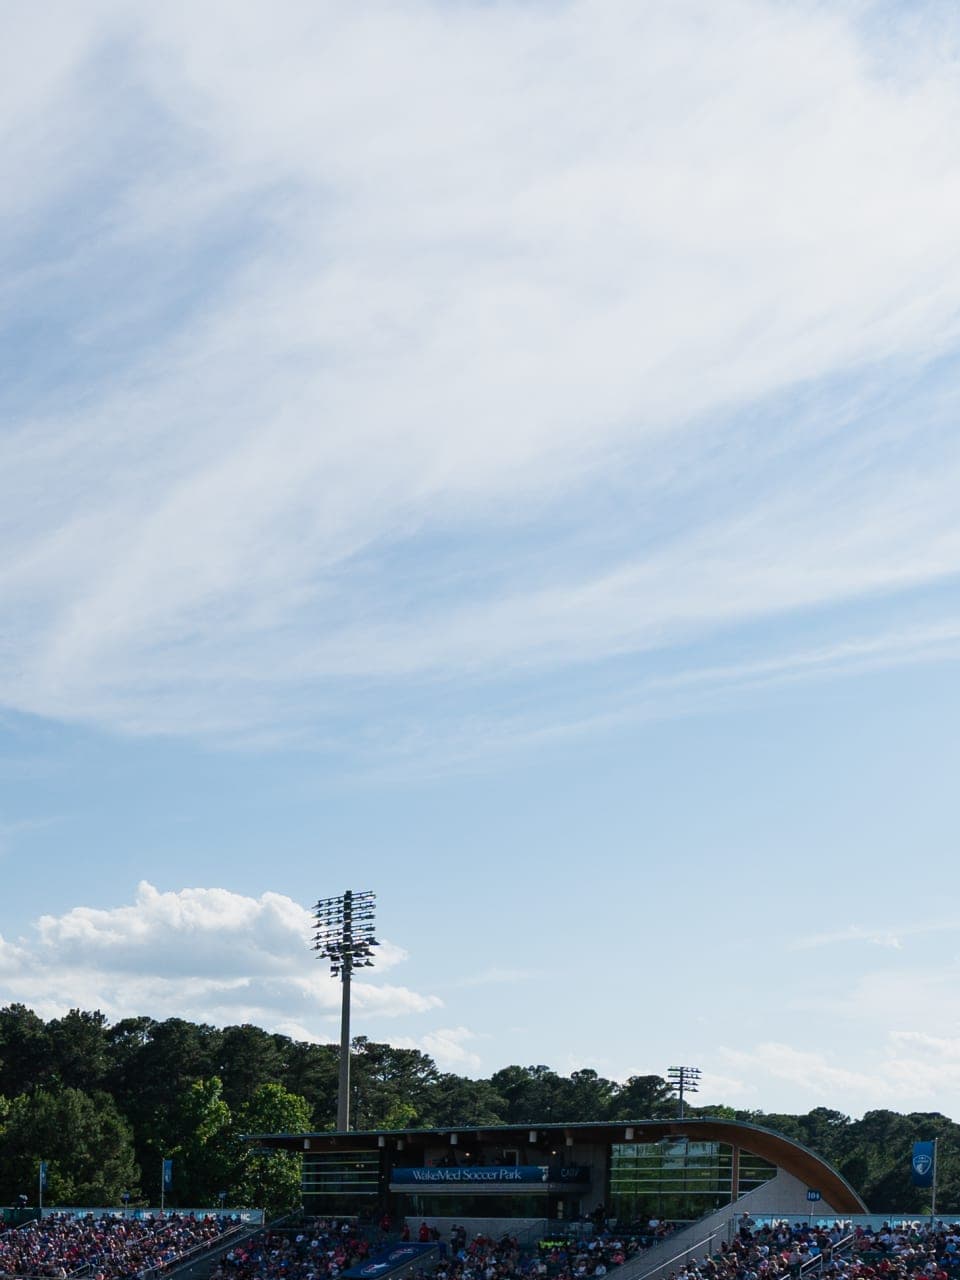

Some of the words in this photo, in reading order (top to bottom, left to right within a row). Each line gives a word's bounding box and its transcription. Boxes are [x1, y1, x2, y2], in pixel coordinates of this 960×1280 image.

[412, 1170, 461, 1181] WakeMed
[462, 1169, 498, 1180] Soccer
[500, 1169, 522, 1180] Park
